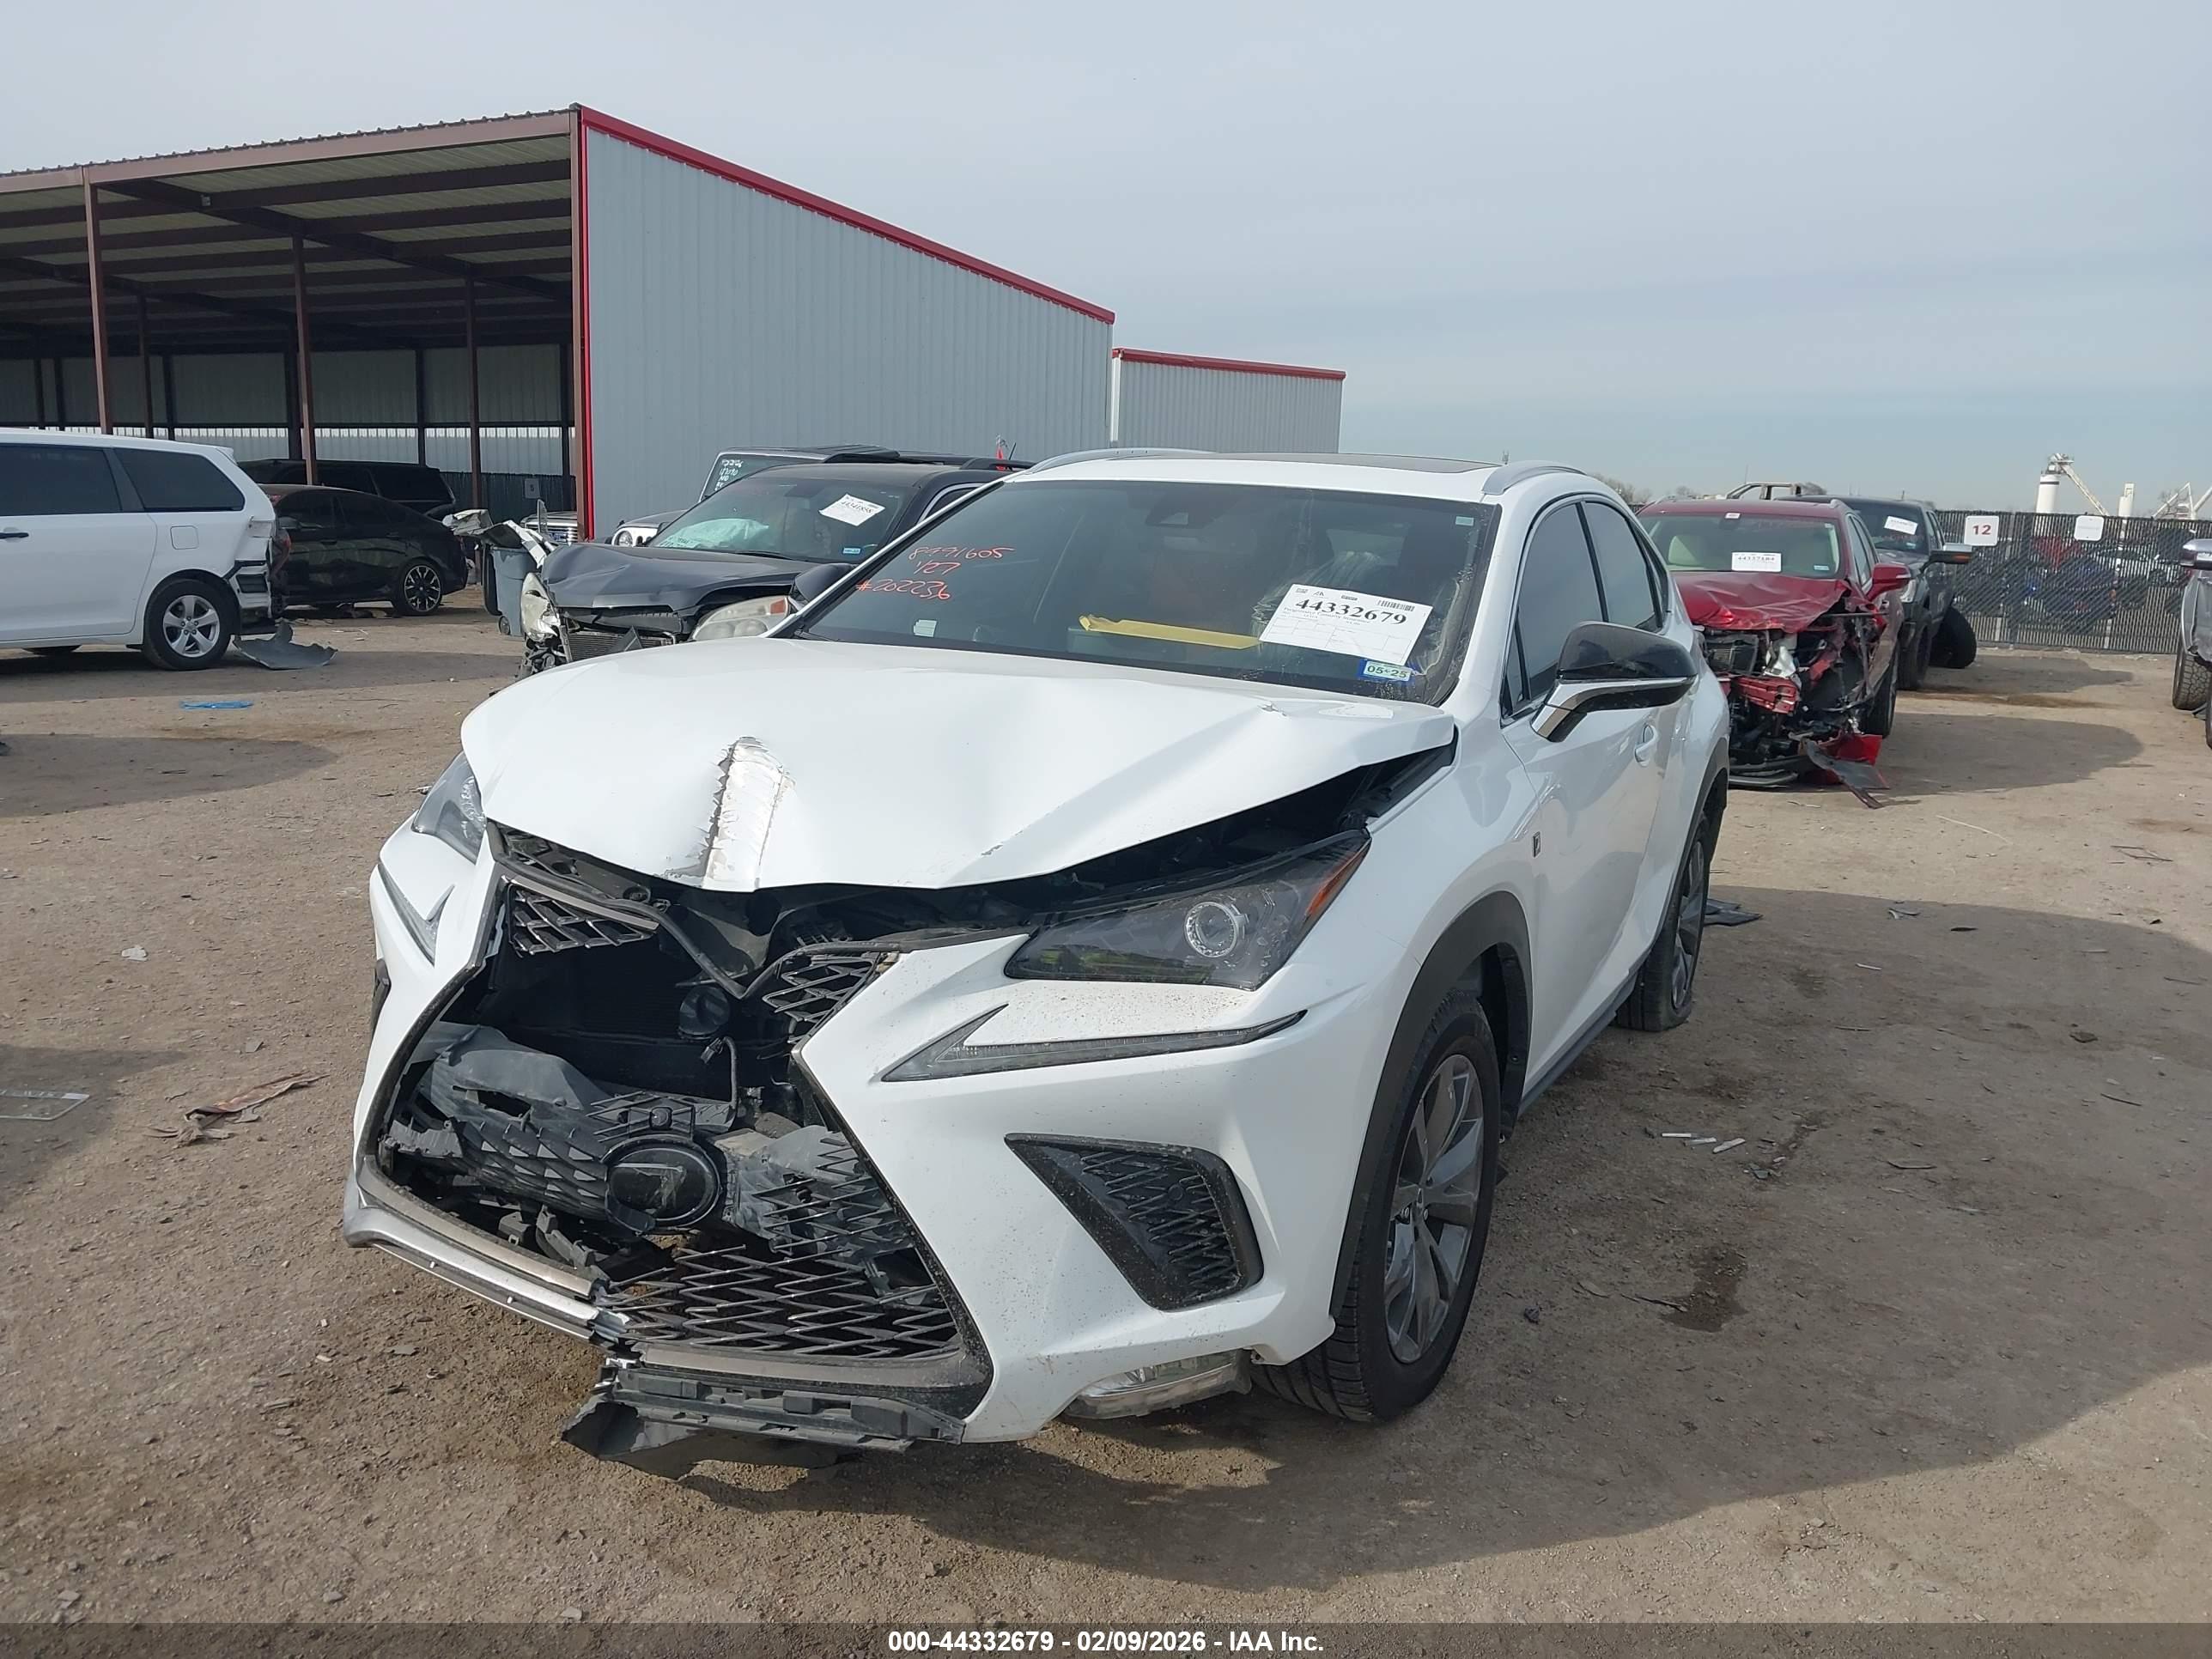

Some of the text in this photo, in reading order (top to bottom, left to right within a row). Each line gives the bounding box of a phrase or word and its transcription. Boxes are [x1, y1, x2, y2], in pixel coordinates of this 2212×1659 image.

[1972, 525, 1992, 535] 12
[1295, 599, 1408, 625] 44332679
[1390, 669, 1407, 678] 25
